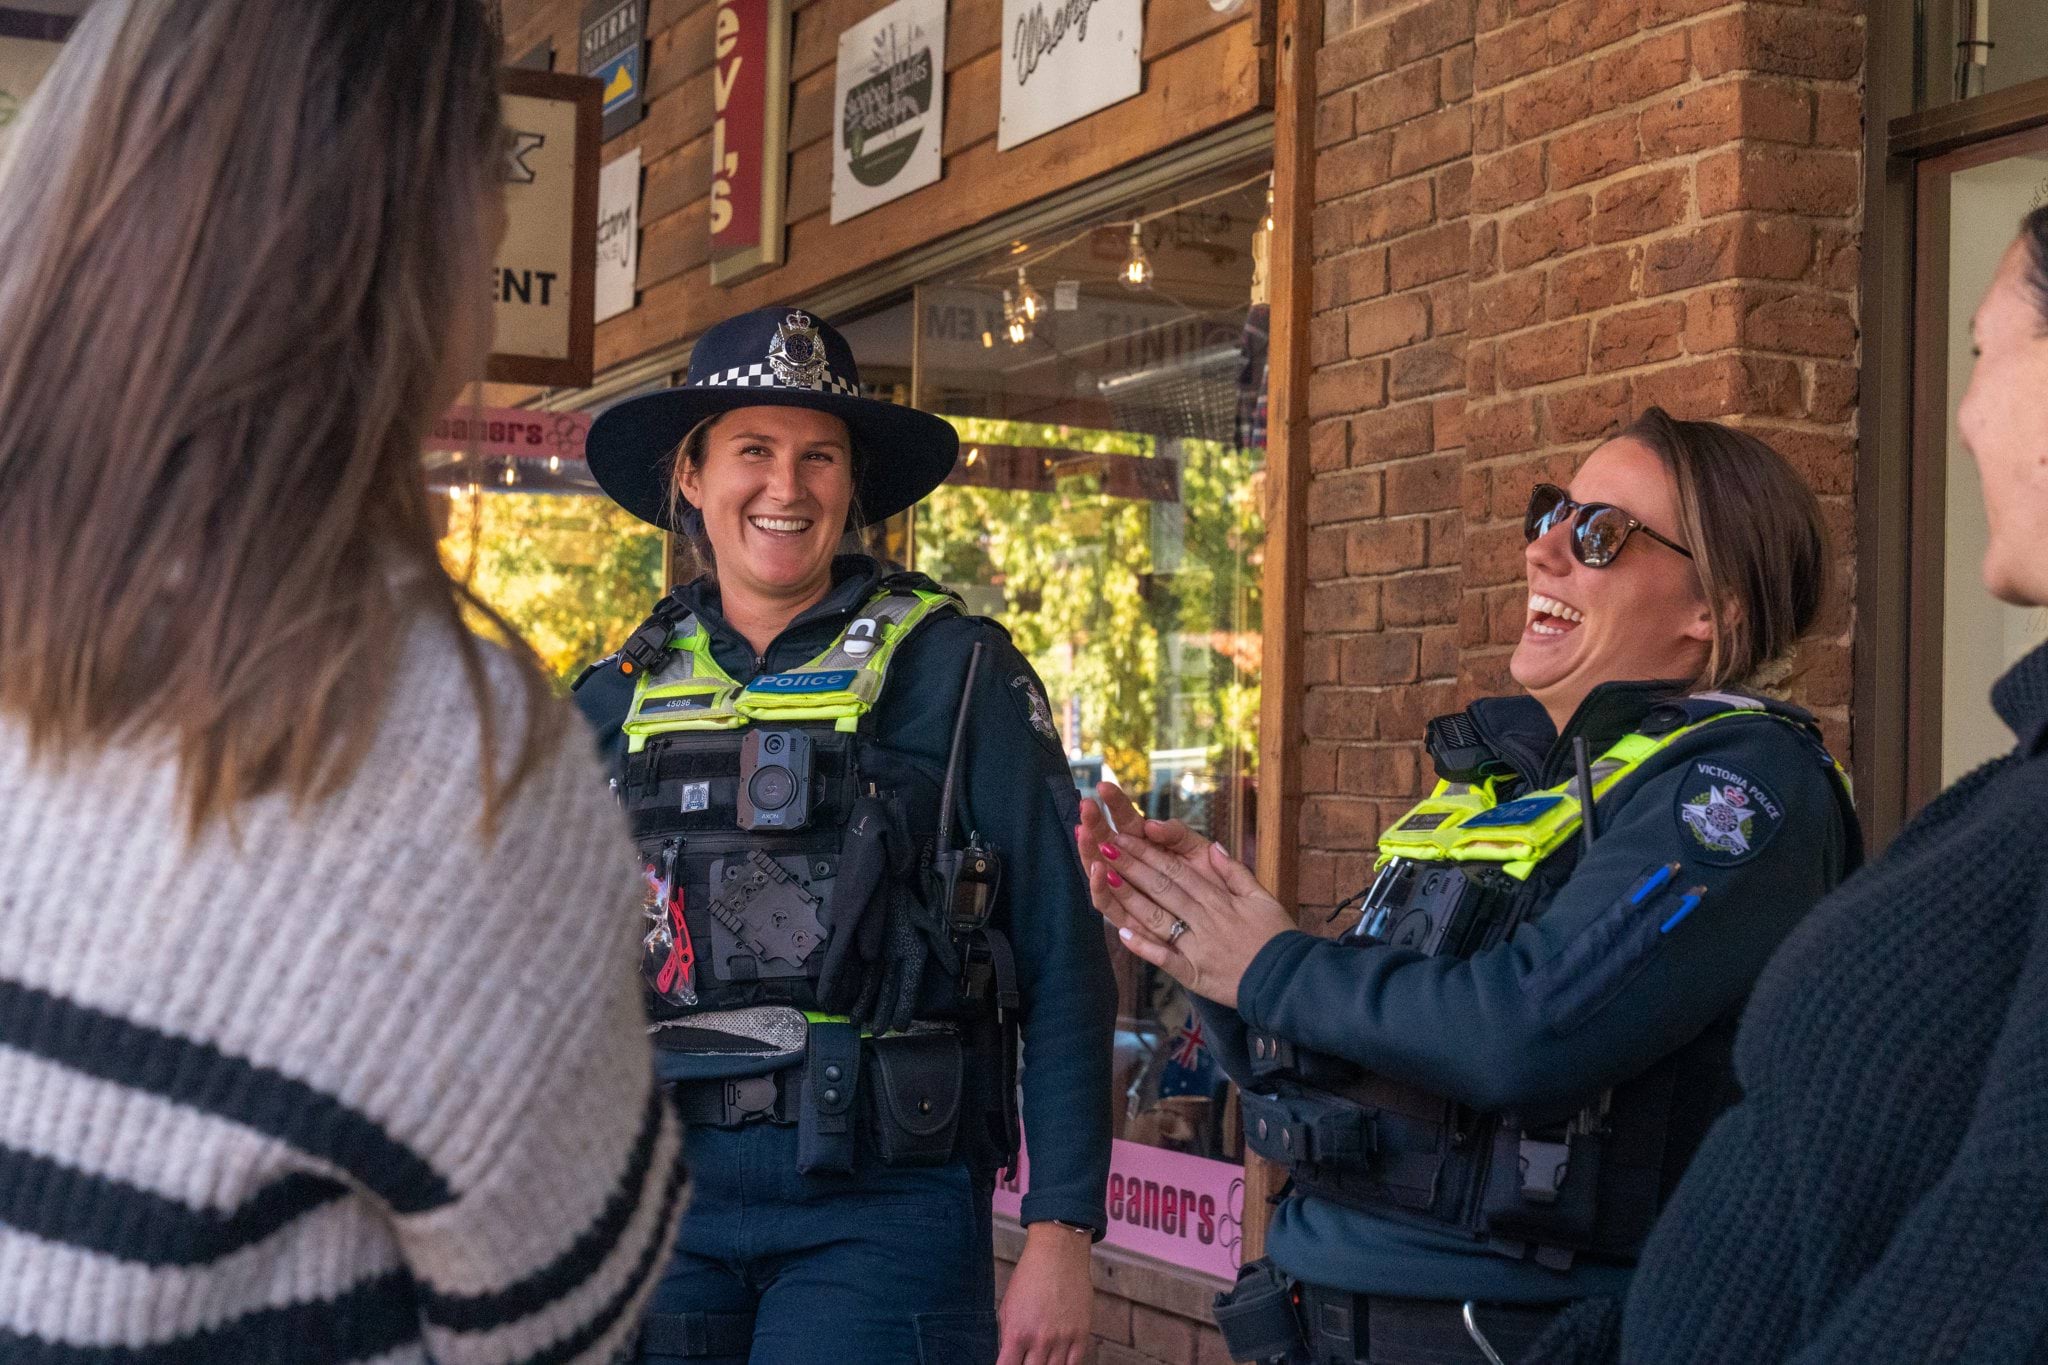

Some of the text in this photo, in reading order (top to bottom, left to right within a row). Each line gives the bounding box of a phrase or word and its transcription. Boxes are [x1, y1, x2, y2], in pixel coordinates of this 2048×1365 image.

[494, 266, 557, 305] NT
[756, 674, 844, 688] Police
[665, 698, 691, 708] 45096
[1697, 763, 1782, 821] VICTORIA POLICE
